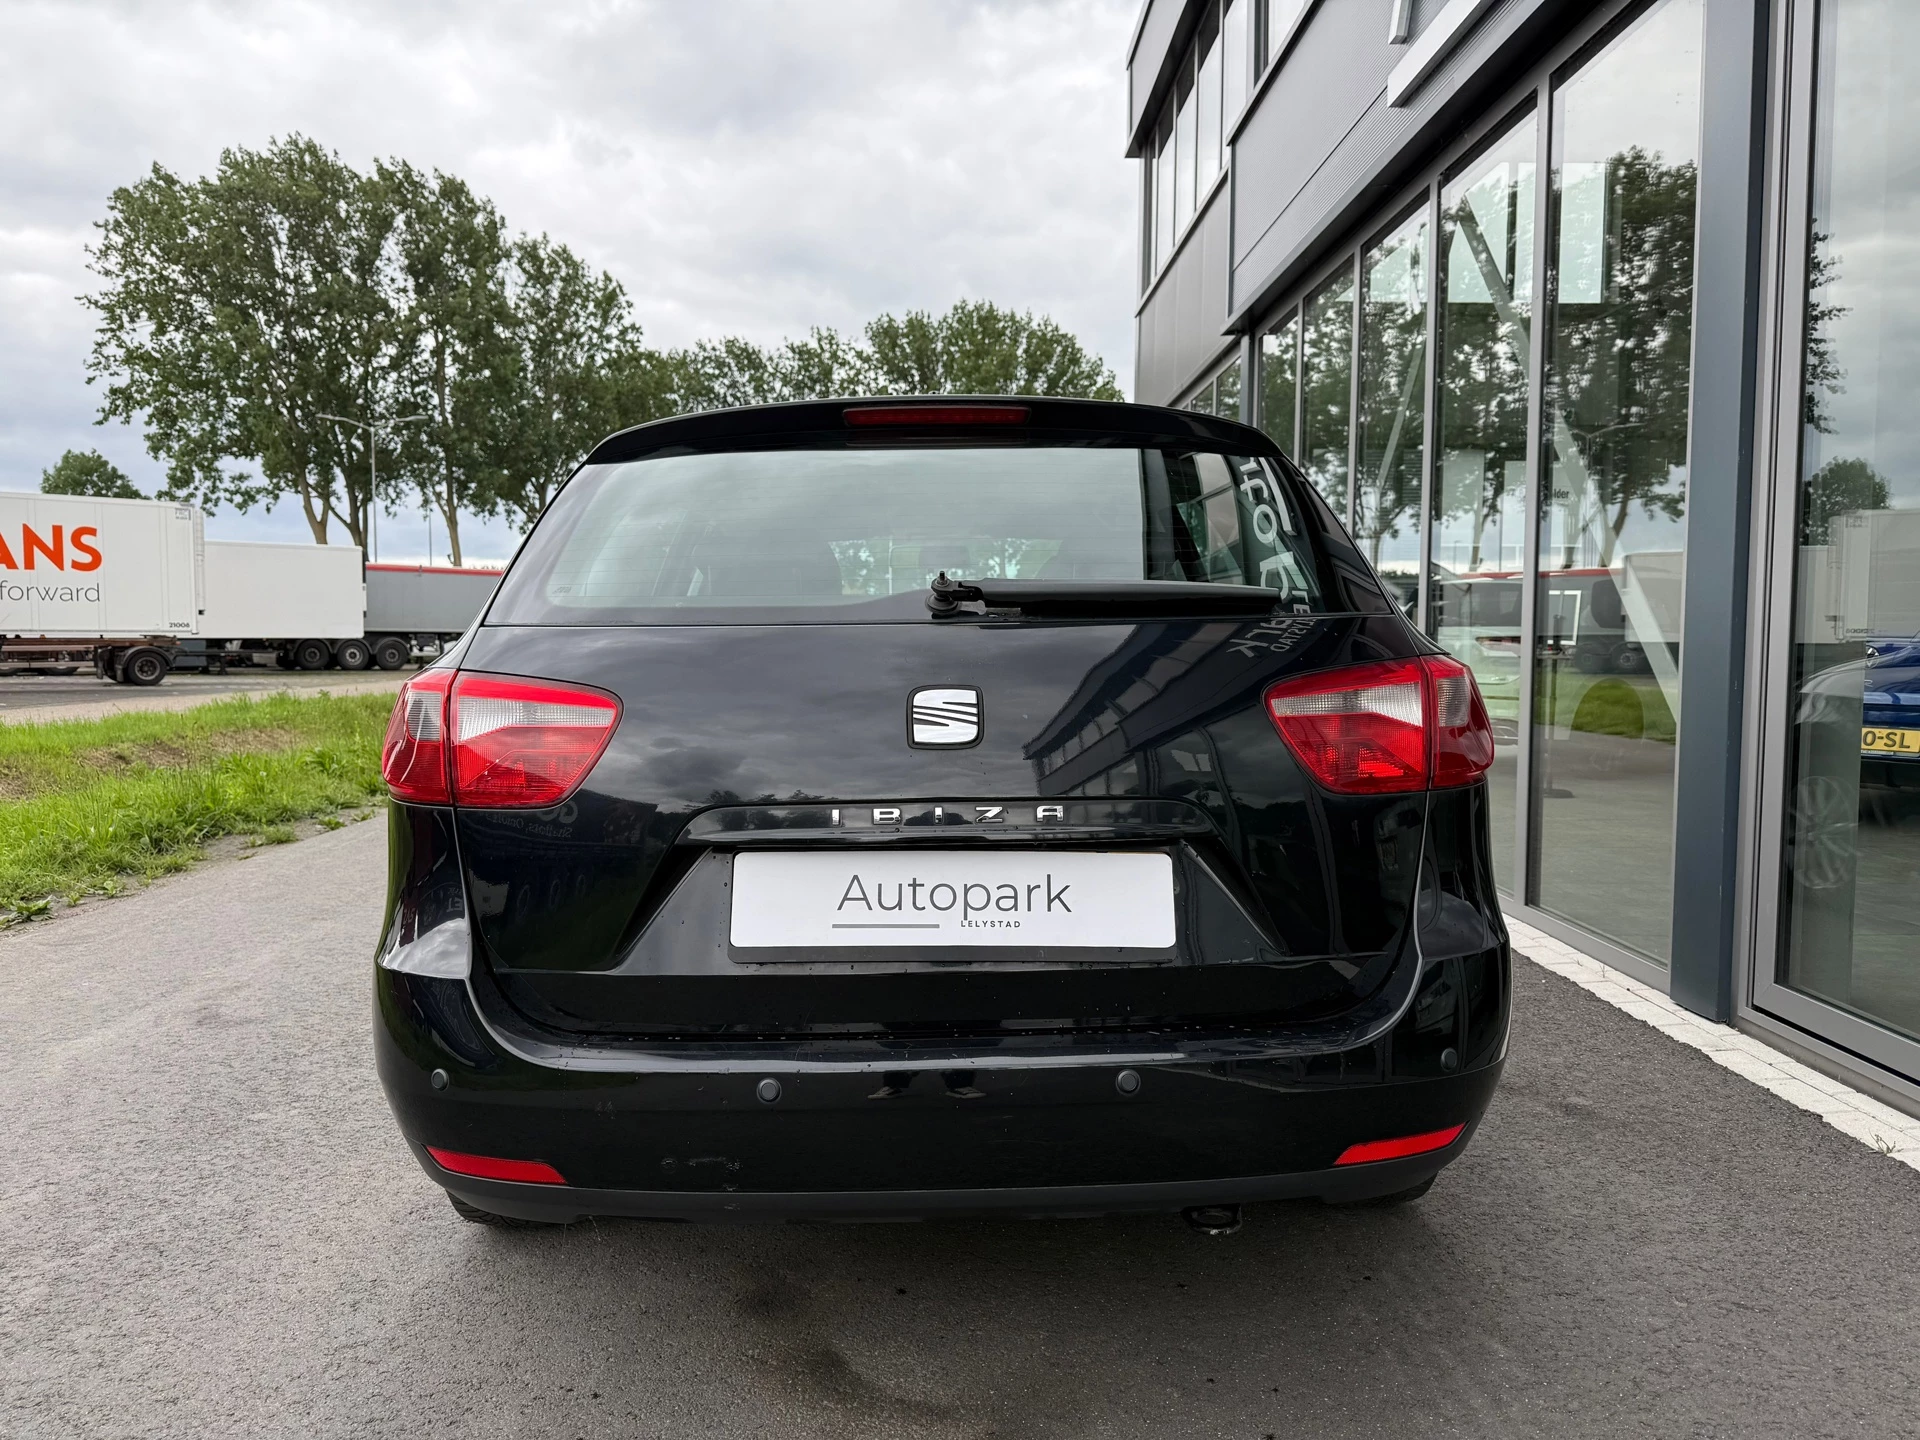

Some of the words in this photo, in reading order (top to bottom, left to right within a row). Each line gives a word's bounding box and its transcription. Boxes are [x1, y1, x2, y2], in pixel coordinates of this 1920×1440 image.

[0, 580, 100, 602] forward
[831, 805, 1064, 825] IBIZA
[837, 873, 1073, 921] Autopark
[960, 920, 1021, 928] LELYSTAD
